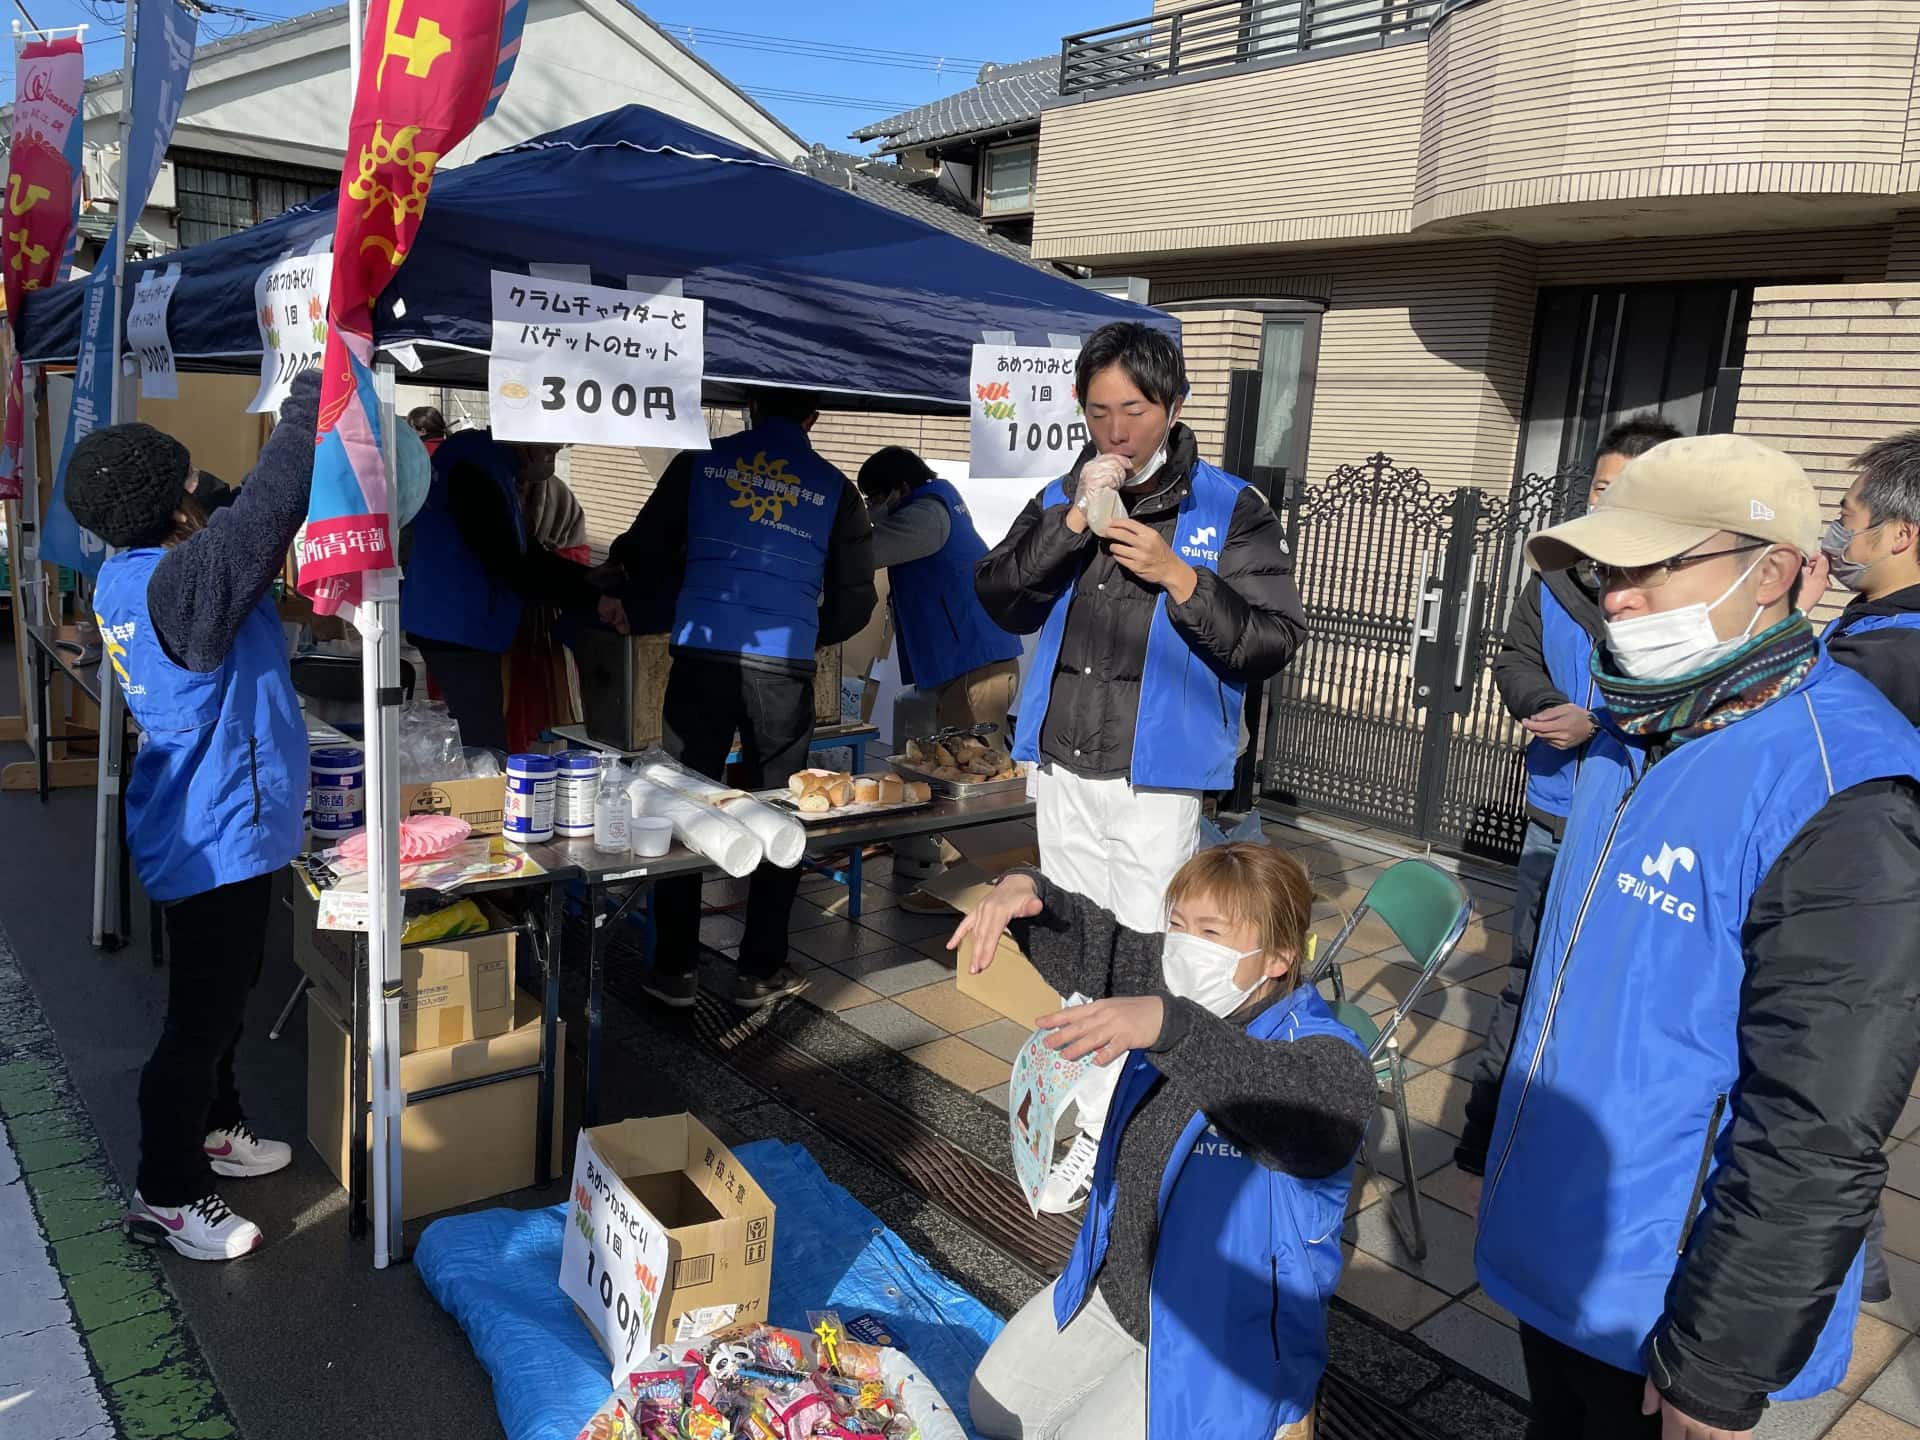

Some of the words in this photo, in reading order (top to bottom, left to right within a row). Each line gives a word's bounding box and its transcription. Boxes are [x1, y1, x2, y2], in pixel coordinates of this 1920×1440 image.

[285, 304, 298, 326] 1回
[510, 286, 687, 330] クラムチャウダーと
[520, 324, 678, 362] バゲットのセット
[541, 375, 676, 421] 300円
[1031, 384, 1052, 402] 1回
[1008, 422, 1089, 451] 100円
[1616, 872, 1697, 923] 守山YEG
[586, 1160, 648, 1254] あめつかみとり
[606, 1223, 623, 1259] 1回
[585, 1249, 641, 1364] 100円
